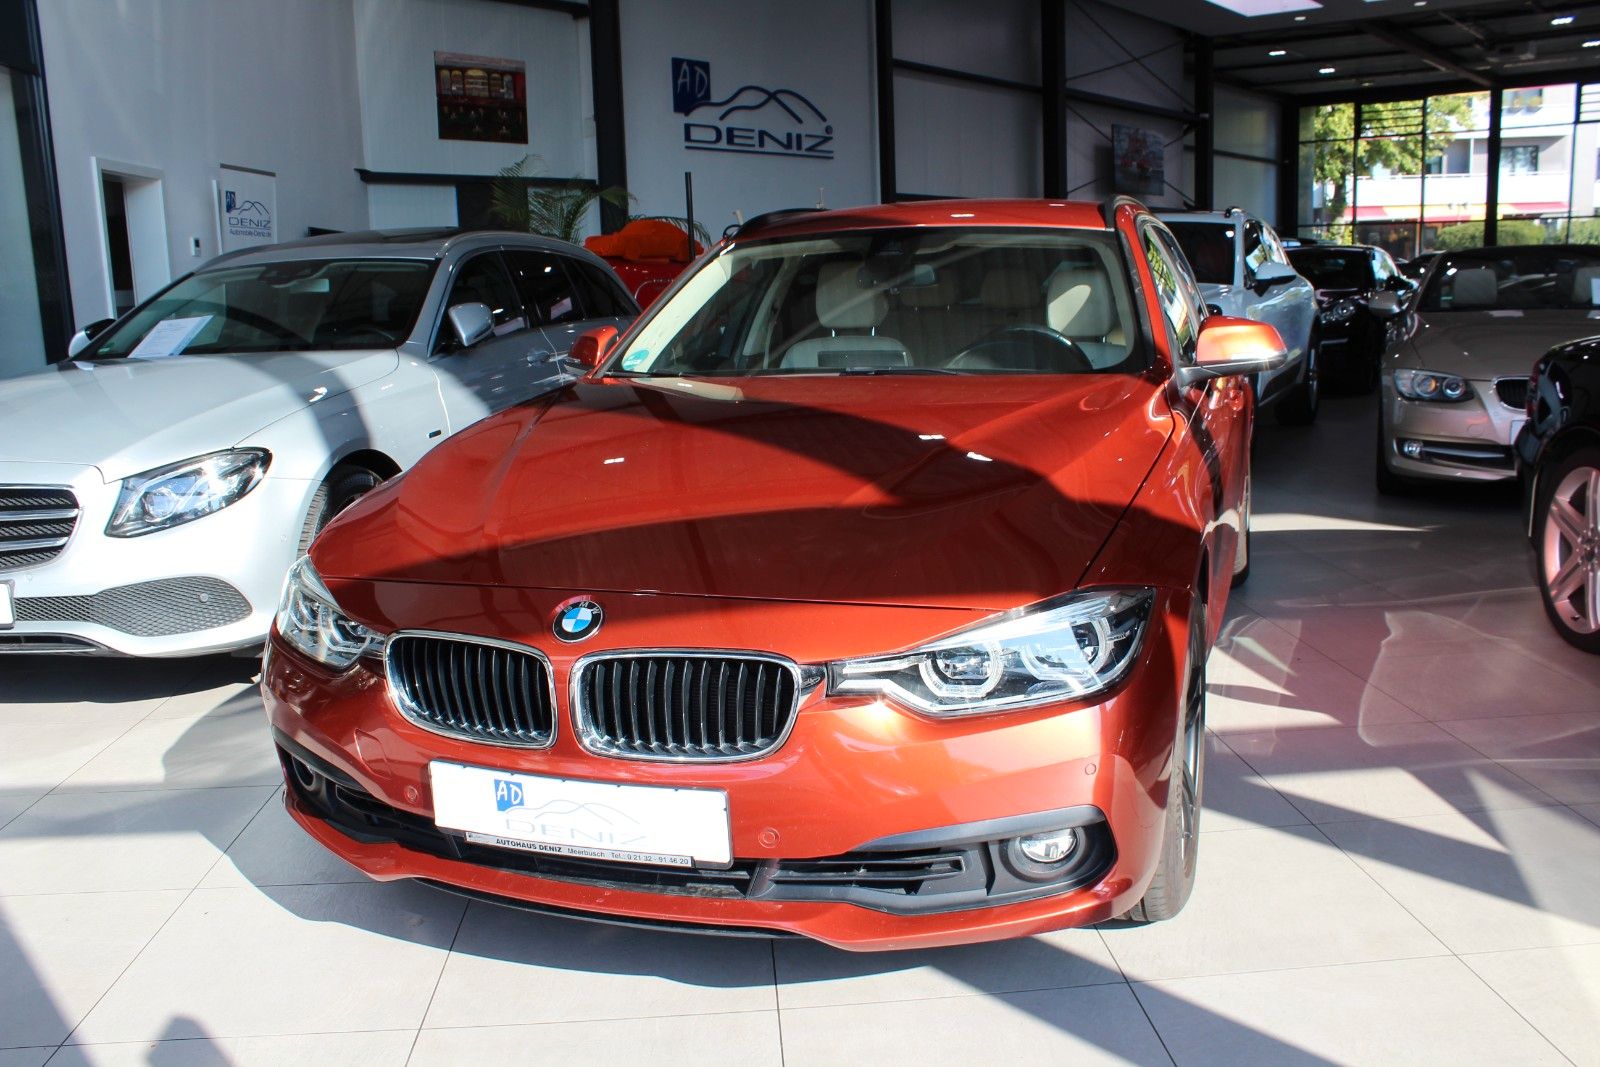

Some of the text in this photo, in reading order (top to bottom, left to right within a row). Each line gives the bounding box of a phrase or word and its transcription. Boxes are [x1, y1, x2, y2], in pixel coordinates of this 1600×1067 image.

[684, 123, 834, 154] DENIZ
[228, 216, 271, 229] DENIZ
[496, 780, 522, 805] AD
[505, 818, 647, 845] DENIZ
[496, 839, 537, 850] AUTOHAUS
[538, 844, 562, 853] DENIZ
[567, 848, 605, 858] Meerbusch
